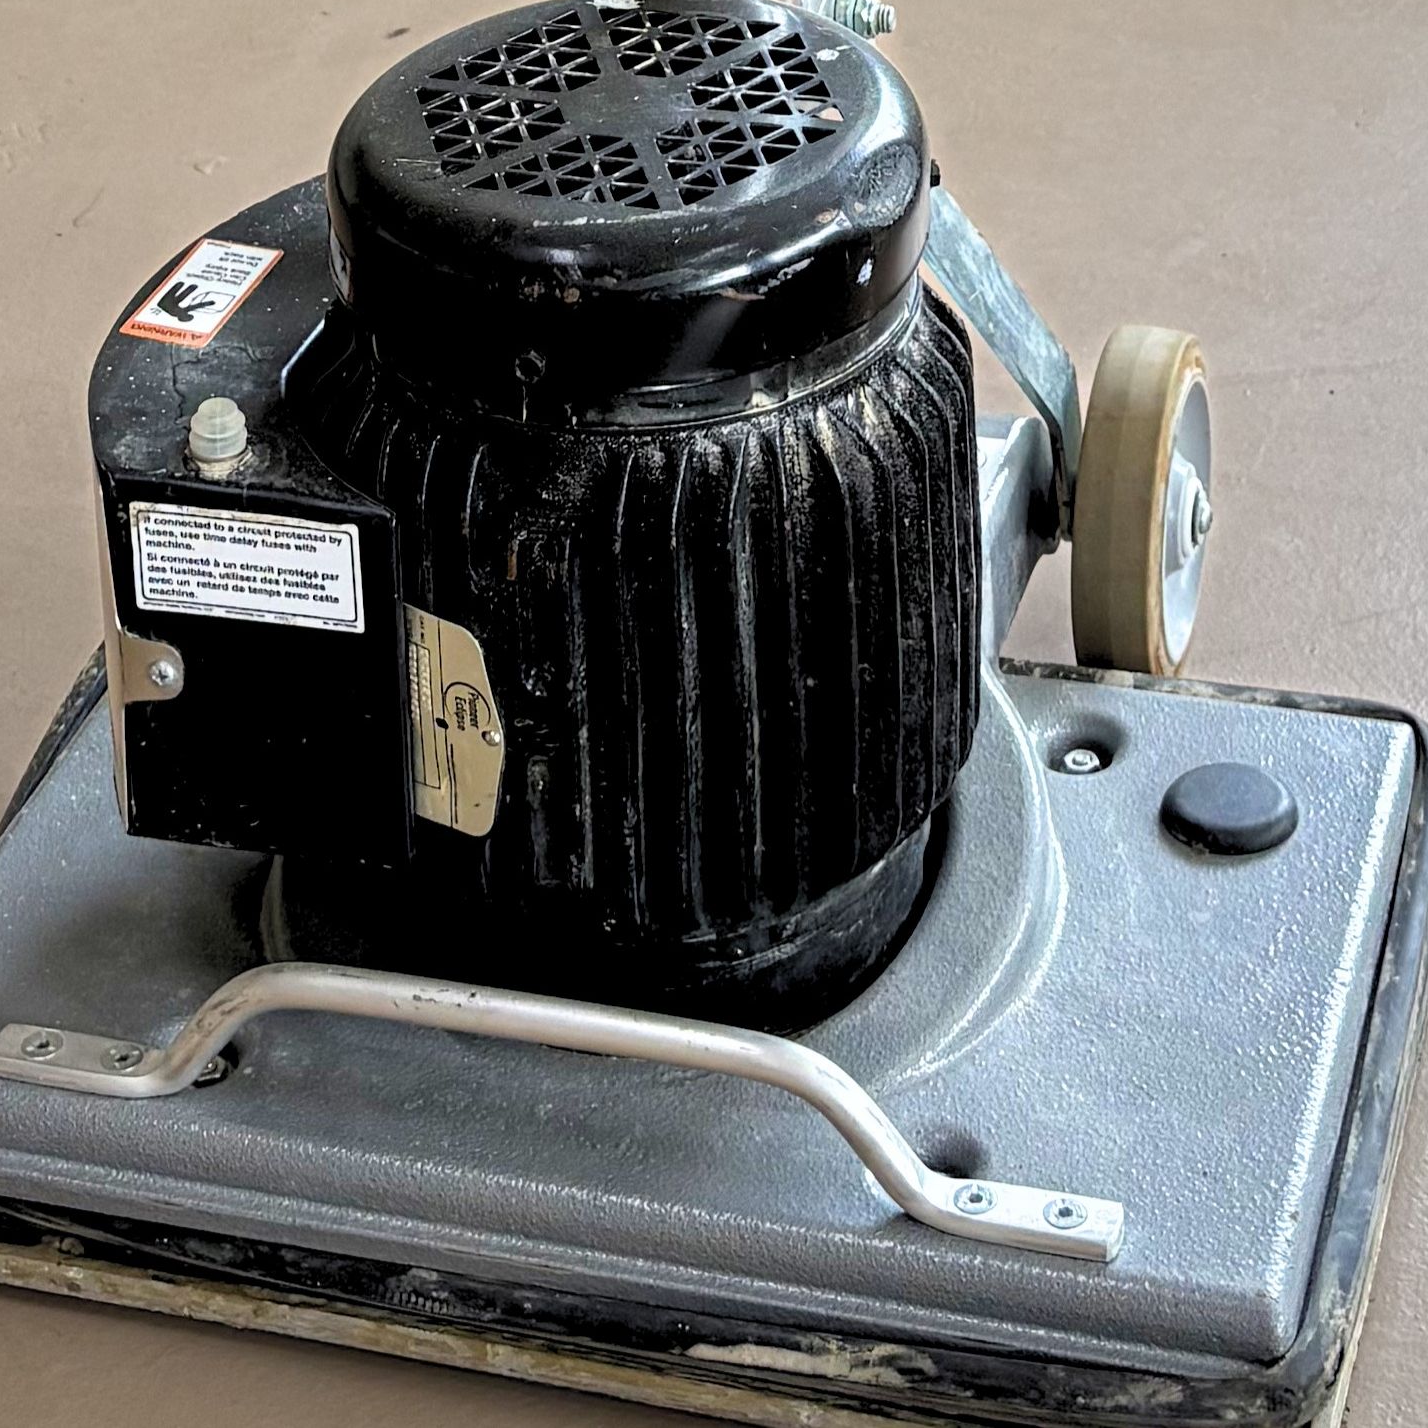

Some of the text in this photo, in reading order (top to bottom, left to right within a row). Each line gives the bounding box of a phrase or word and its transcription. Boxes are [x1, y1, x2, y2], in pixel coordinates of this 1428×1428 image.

[145, 539, 195, 551] machine.
[153, 517, 212, 531] connected
[214, 521, 225, 532] to
[237, 525, 272, 537] circuit
[274, 529, 327, 544] protected
[329, 534, 343, 547] by
[180, 531, 200, 540] use
[203, 532, 227, 543] time
[229, 535, 258, 549] delay
[261, 538, 292, 551] fuses
[294, 543, 318, 554] with
[147, 564, 168, 574] des
[260, 575, 281, 586] des
[283, 577, 326, 592] fusibles
[160, 555, 211, 567] connecté
[223, 561, 237, 570] un
[240, 562, 274, 574] circuit
[321, 571, 340, 582] par
[148, 576, 174, 586] avec
[177, 578, 191, 587] un
[196, 580, 229, 592] retard
[232, 584, 246, 593] de
[248, 585, 282, 598] temps
[284, 589, 310, 602] avec
[149, 586, 199, 599] machine.
[454, 695, 466, 732] Eclipse
[468, 690, 480, 731] Pioneer
